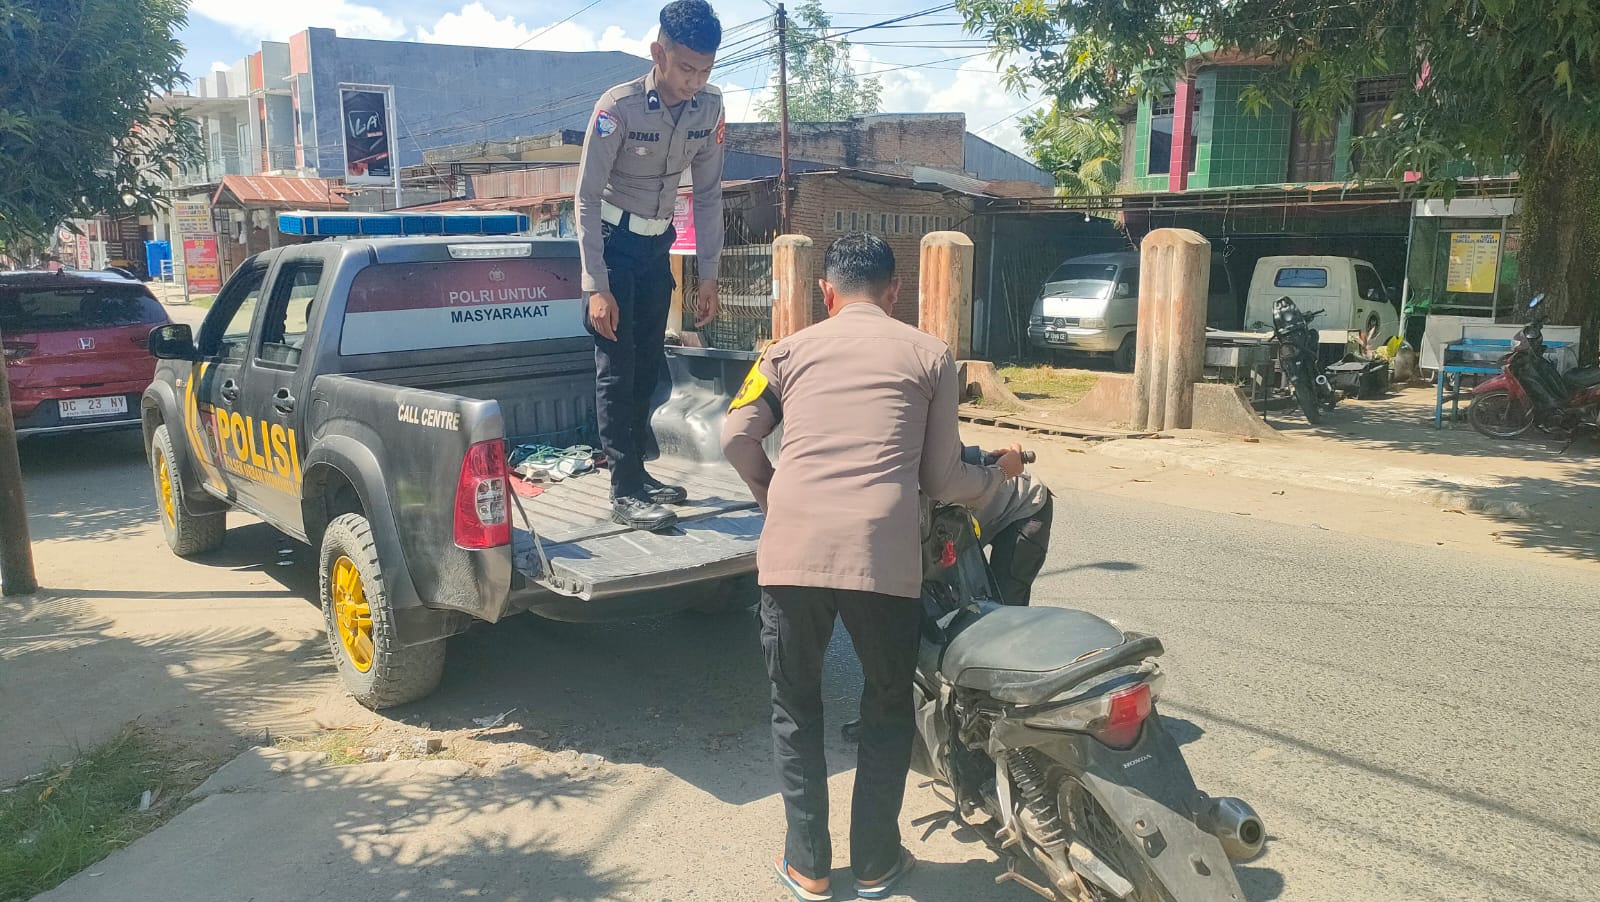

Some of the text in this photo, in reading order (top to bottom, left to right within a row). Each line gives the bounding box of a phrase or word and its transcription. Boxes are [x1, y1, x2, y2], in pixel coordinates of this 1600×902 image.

[449, 286, 547, 304] POLRI UNTUK
[451, 305, 550, 323] MASYARAKAT
[62, 401, 76, 412] DC
[88, 399, 102, 410] 23
[398, 404, 461, 431] CALL CENTRE
[216, 407, 301, 483] POLISI
[1123, 754, 1152, 768] HONDA
